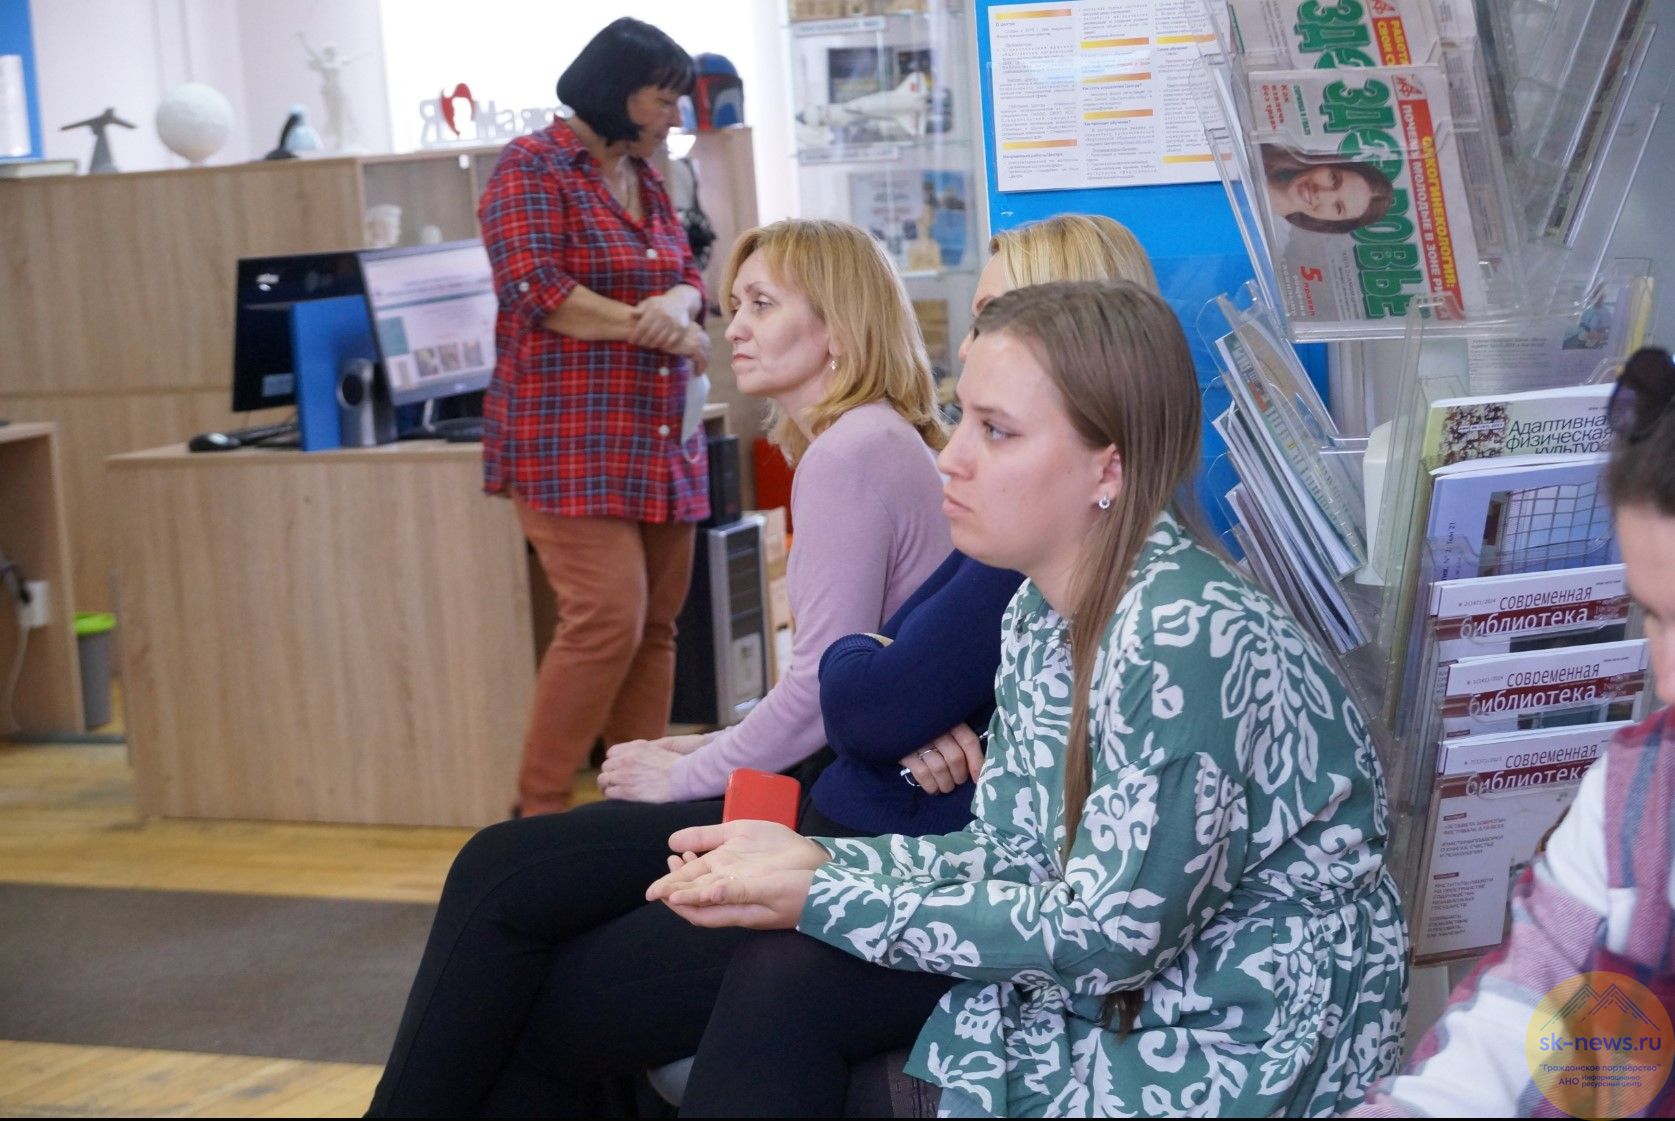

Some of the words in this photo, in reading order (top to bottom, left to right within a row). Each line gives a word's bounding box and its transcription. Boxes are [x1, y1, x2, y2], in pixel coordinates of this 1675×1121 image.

[1413, 160, 1434, 231] МОЛОДЫЕ
[1424, 232, 1435, 242] В
[1425, 244, 1440, 276] ЗОНЕ
[1300, 265, 1323, 283] 5
[1509, 415, 1610, 436] Адаптивна
[1499, 586, 1593, 611] современная
[1460, 607, 1589, 640] библиотека
[1506, 663, 1600, 688] современная
[1468, 685, 1596, 717] библиотека
[1505, 744, 1598, 769] современная
